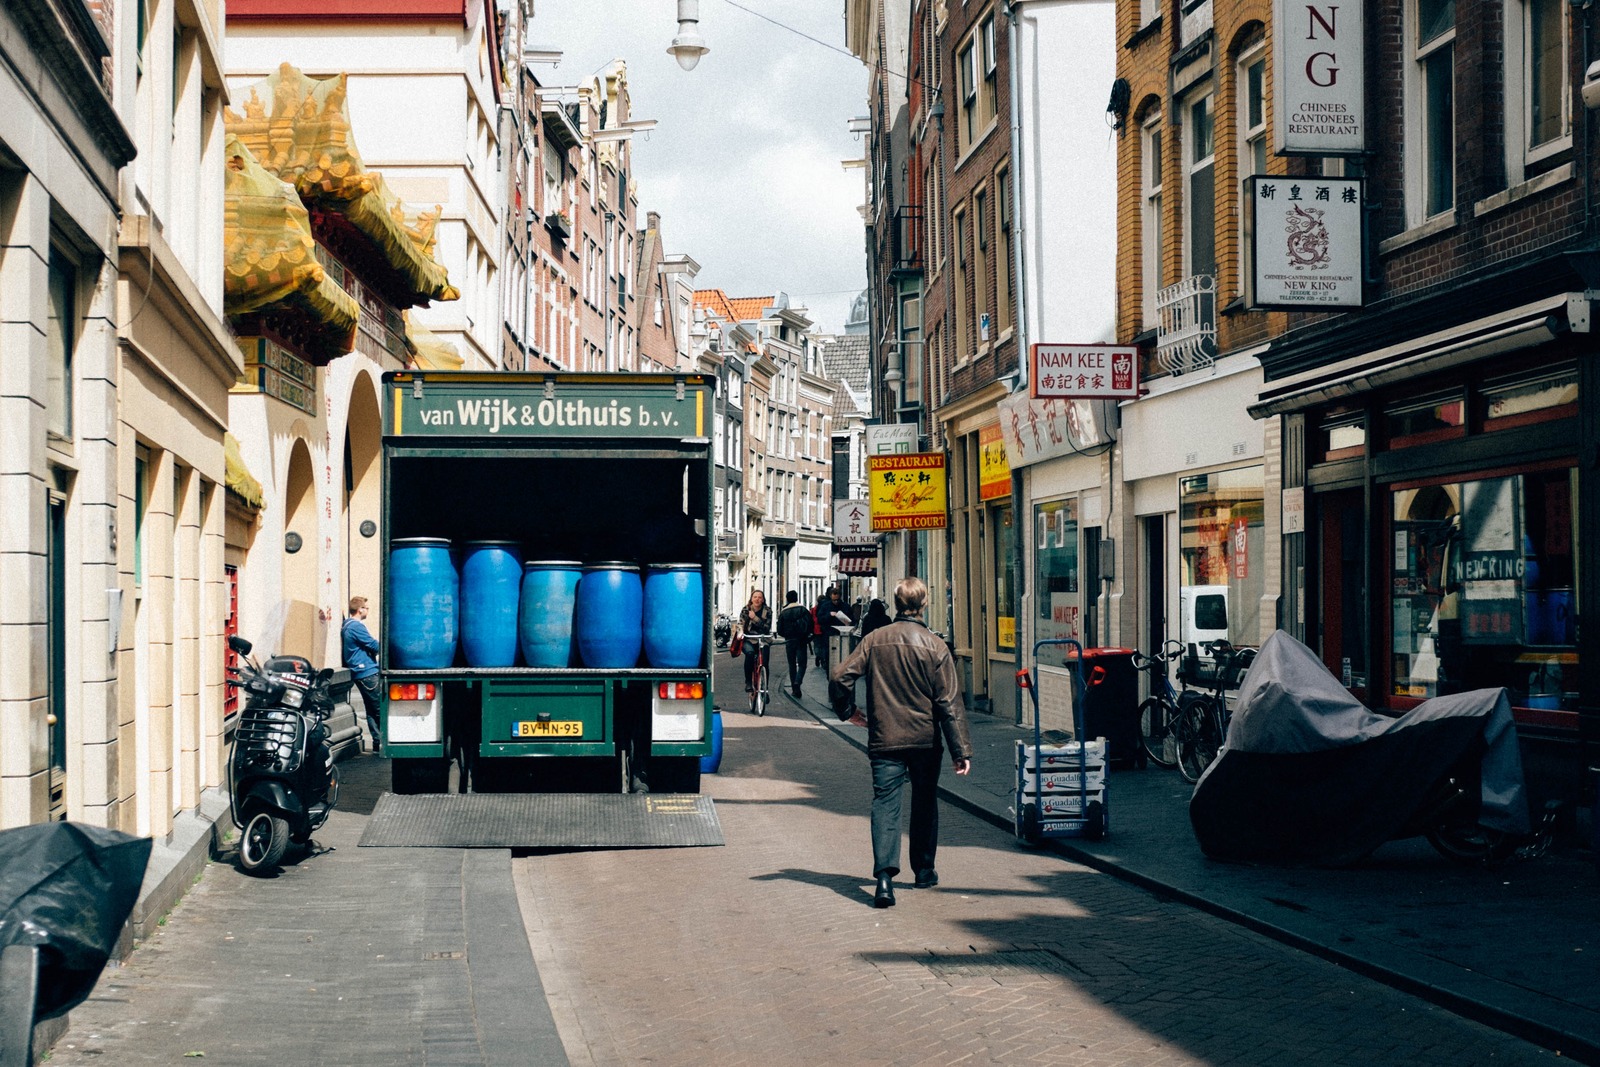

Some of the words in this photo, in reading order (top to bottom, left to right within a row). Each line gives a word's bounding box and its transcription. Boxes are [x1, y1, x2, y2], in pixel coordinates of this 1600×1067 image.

[1300, 103, 1347, 112] CHINEES
[1292, 114, 1355, 123] CANTONEES
[1288, 125, 1359, 135] RESTAURANT
[1284, 281, 1307, 290] NEW
[1311, 281, 1337, 291] KING
[1041, 353, 1072, 368] NAM
[1078, 353, 1105, 368] KEE
[1113, 355, 1131, 375] 南
[1041, 374, 1105, 390] 南記食家
[420, 409, 454, 426] van
[457, 399, 517, 433] Wijk
[520, 404, 536, 426] &
[537, 399, 632, 427] Olthuis
[873, 429, 890, 439] Eat
[890, 427, 912, 439] Mode
[871, 456, 942, 468] RESTAURANT
[874, 519, 891, 529] DIM
[893, 518, 912, 528] SUM
[914, 516, 944, 527] COURT
[1456, 558, 1485, 580] NEW
[1488, 557, 1525, 579] KING
[522, 723, 580, 735] BV-HN-95
